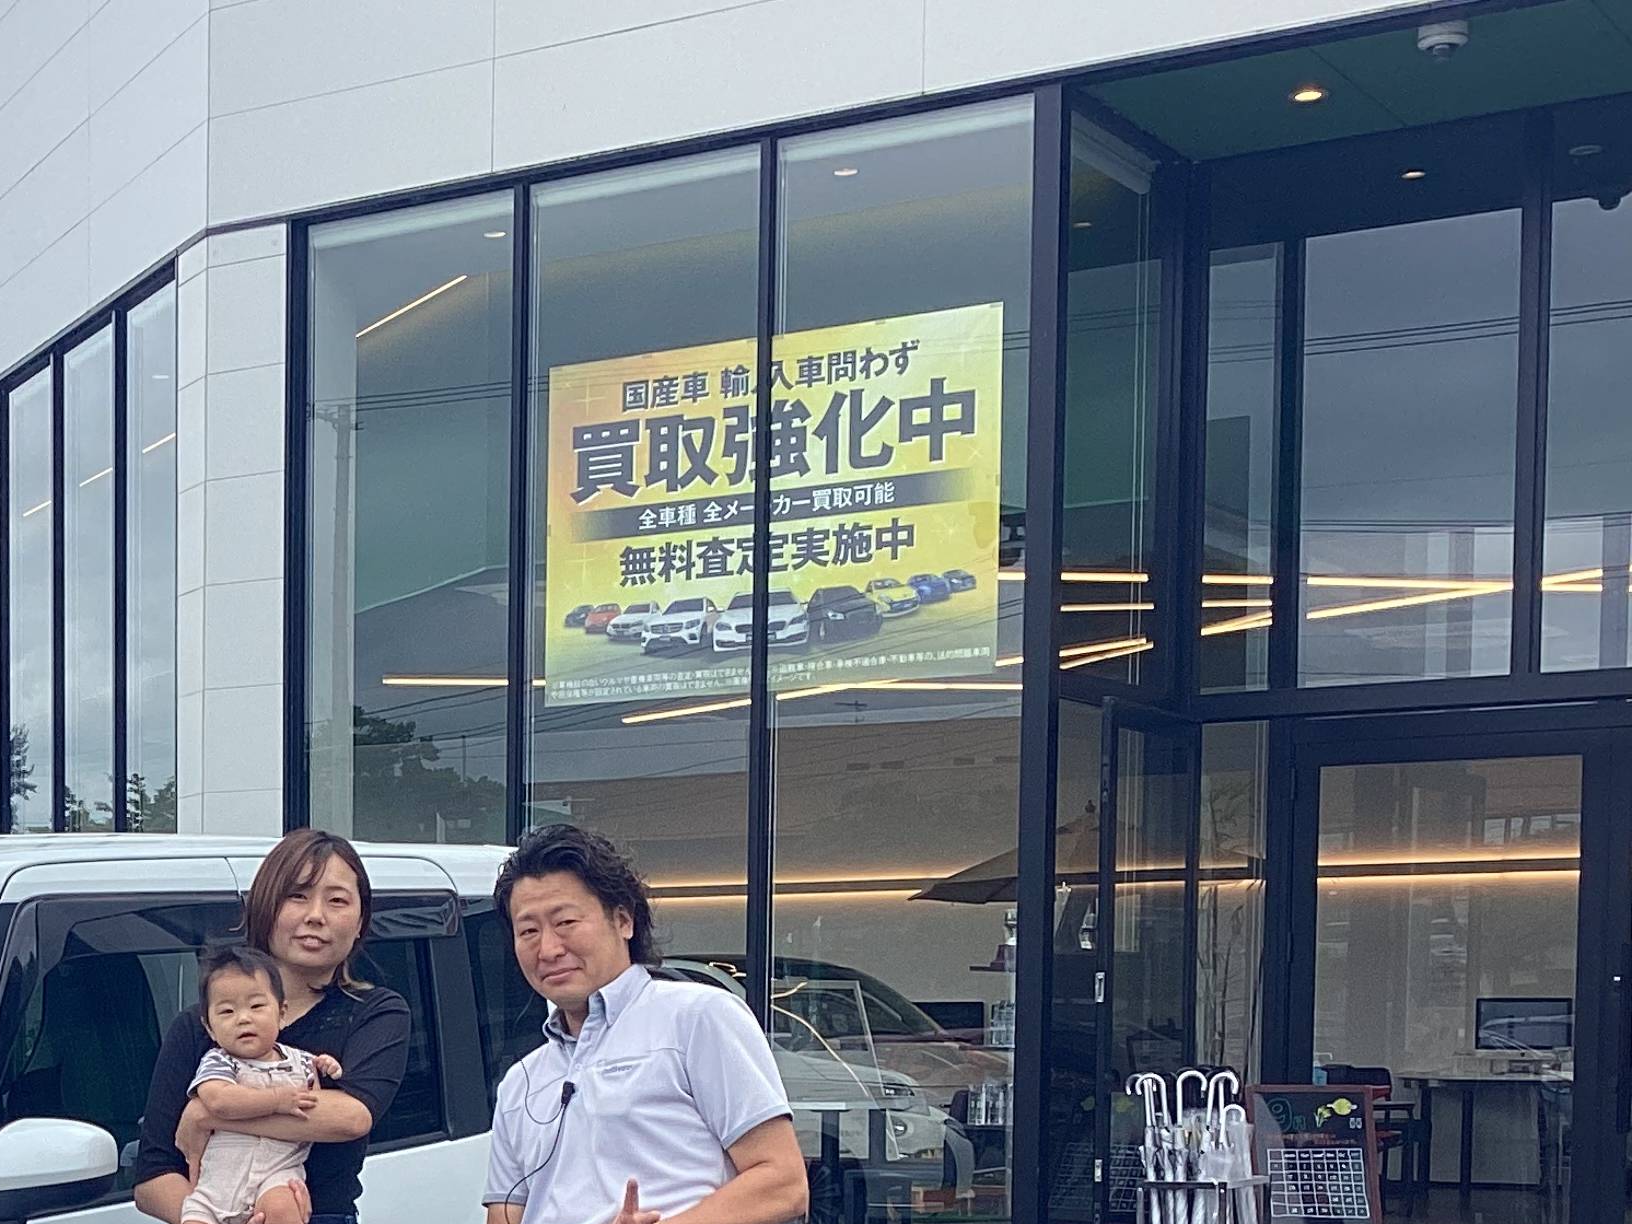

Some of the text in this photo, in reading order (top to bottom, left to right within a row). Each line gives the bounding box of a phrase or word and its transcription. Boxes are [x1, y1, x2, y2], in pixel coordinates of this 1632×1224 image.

[623, 339, 920, 412] 国産車 輸入車問わず
[569, 378, 977, 504] 買取強化中
[638, 481, 896, 531] 全車種 全メーカー買取可能
[619, 517, 917, 588] 無料査定実施中
